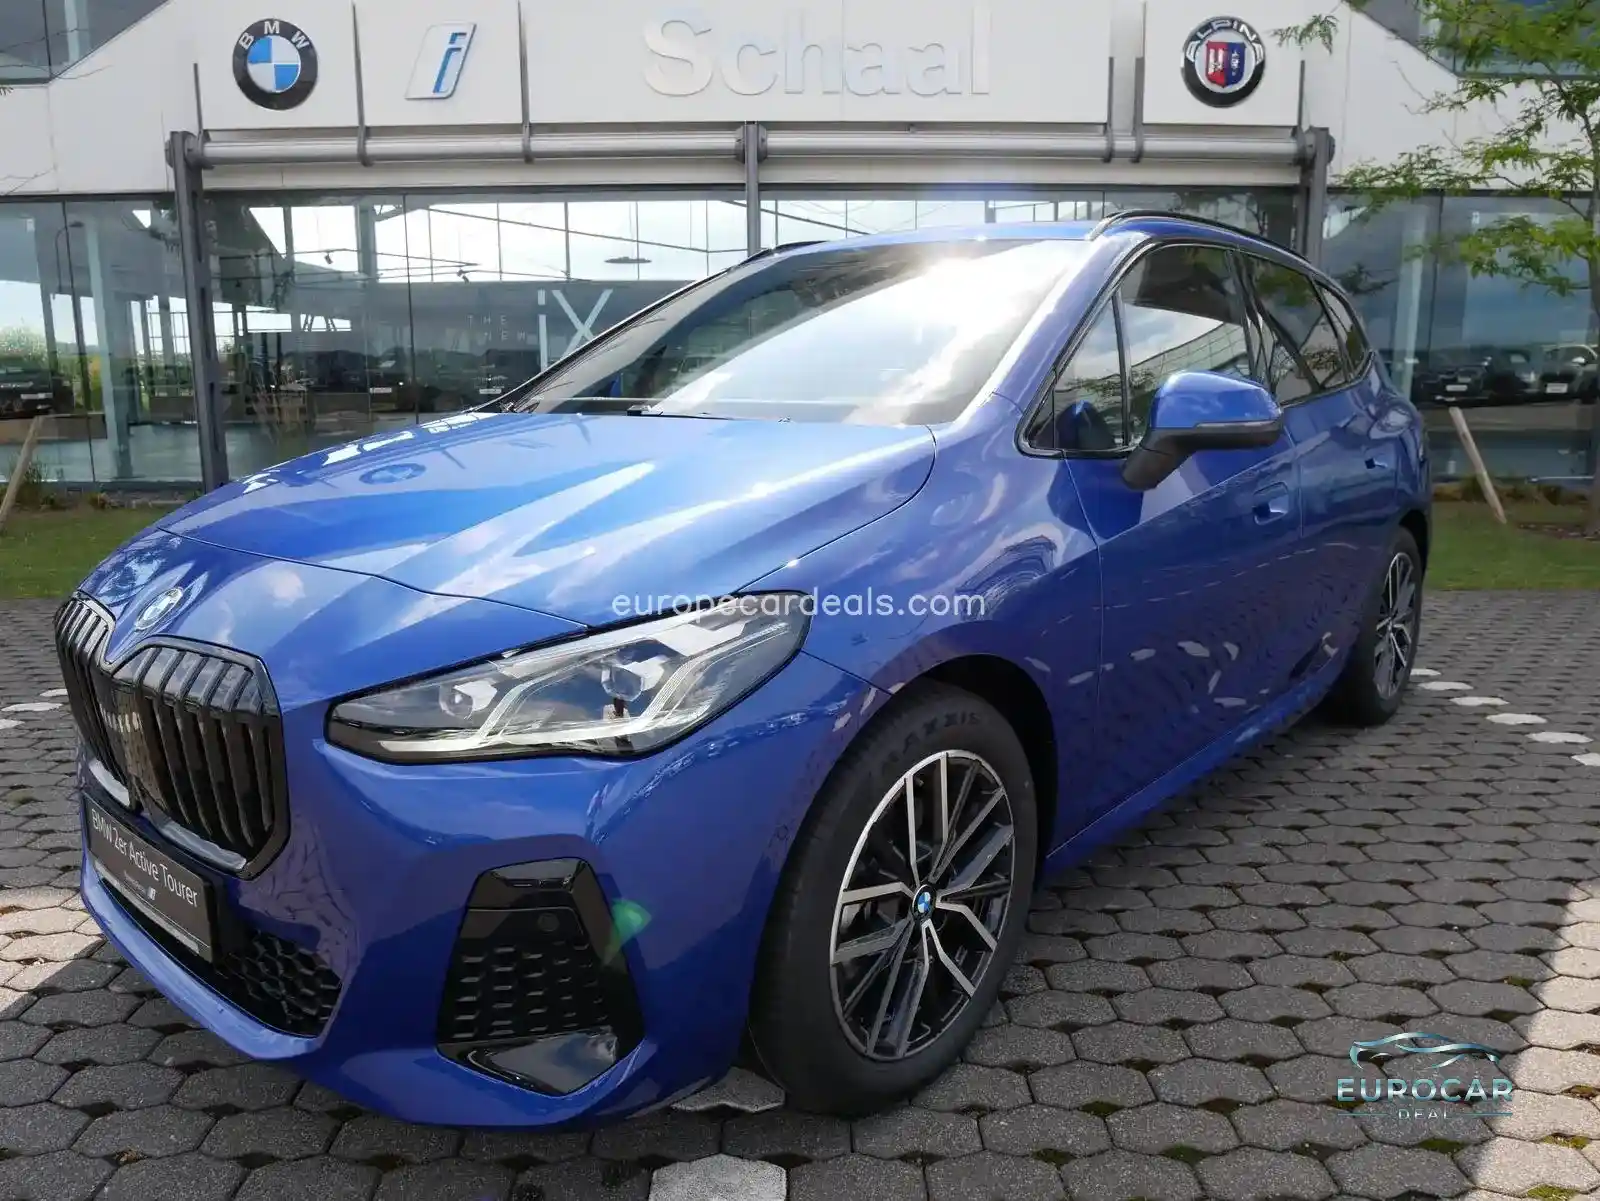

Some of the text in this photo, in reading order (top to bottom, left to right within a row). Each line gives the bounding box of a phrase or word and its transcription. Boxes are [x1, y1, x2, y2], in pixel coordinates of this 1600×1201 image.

[238, 20, 310, 50] BMW
[643, 5, 992, 97] Schaal
[1185, 19, 1264, 65] ALPINA
[466, 314, 508, 328] THE
[537, 289, 614, 373] iX
[91, 808, 113, 843] BMW
[113, 827, 128, 857] 2er
[129, 841, 160, 882] Active
[160, 863, 198, 908] Tourer
